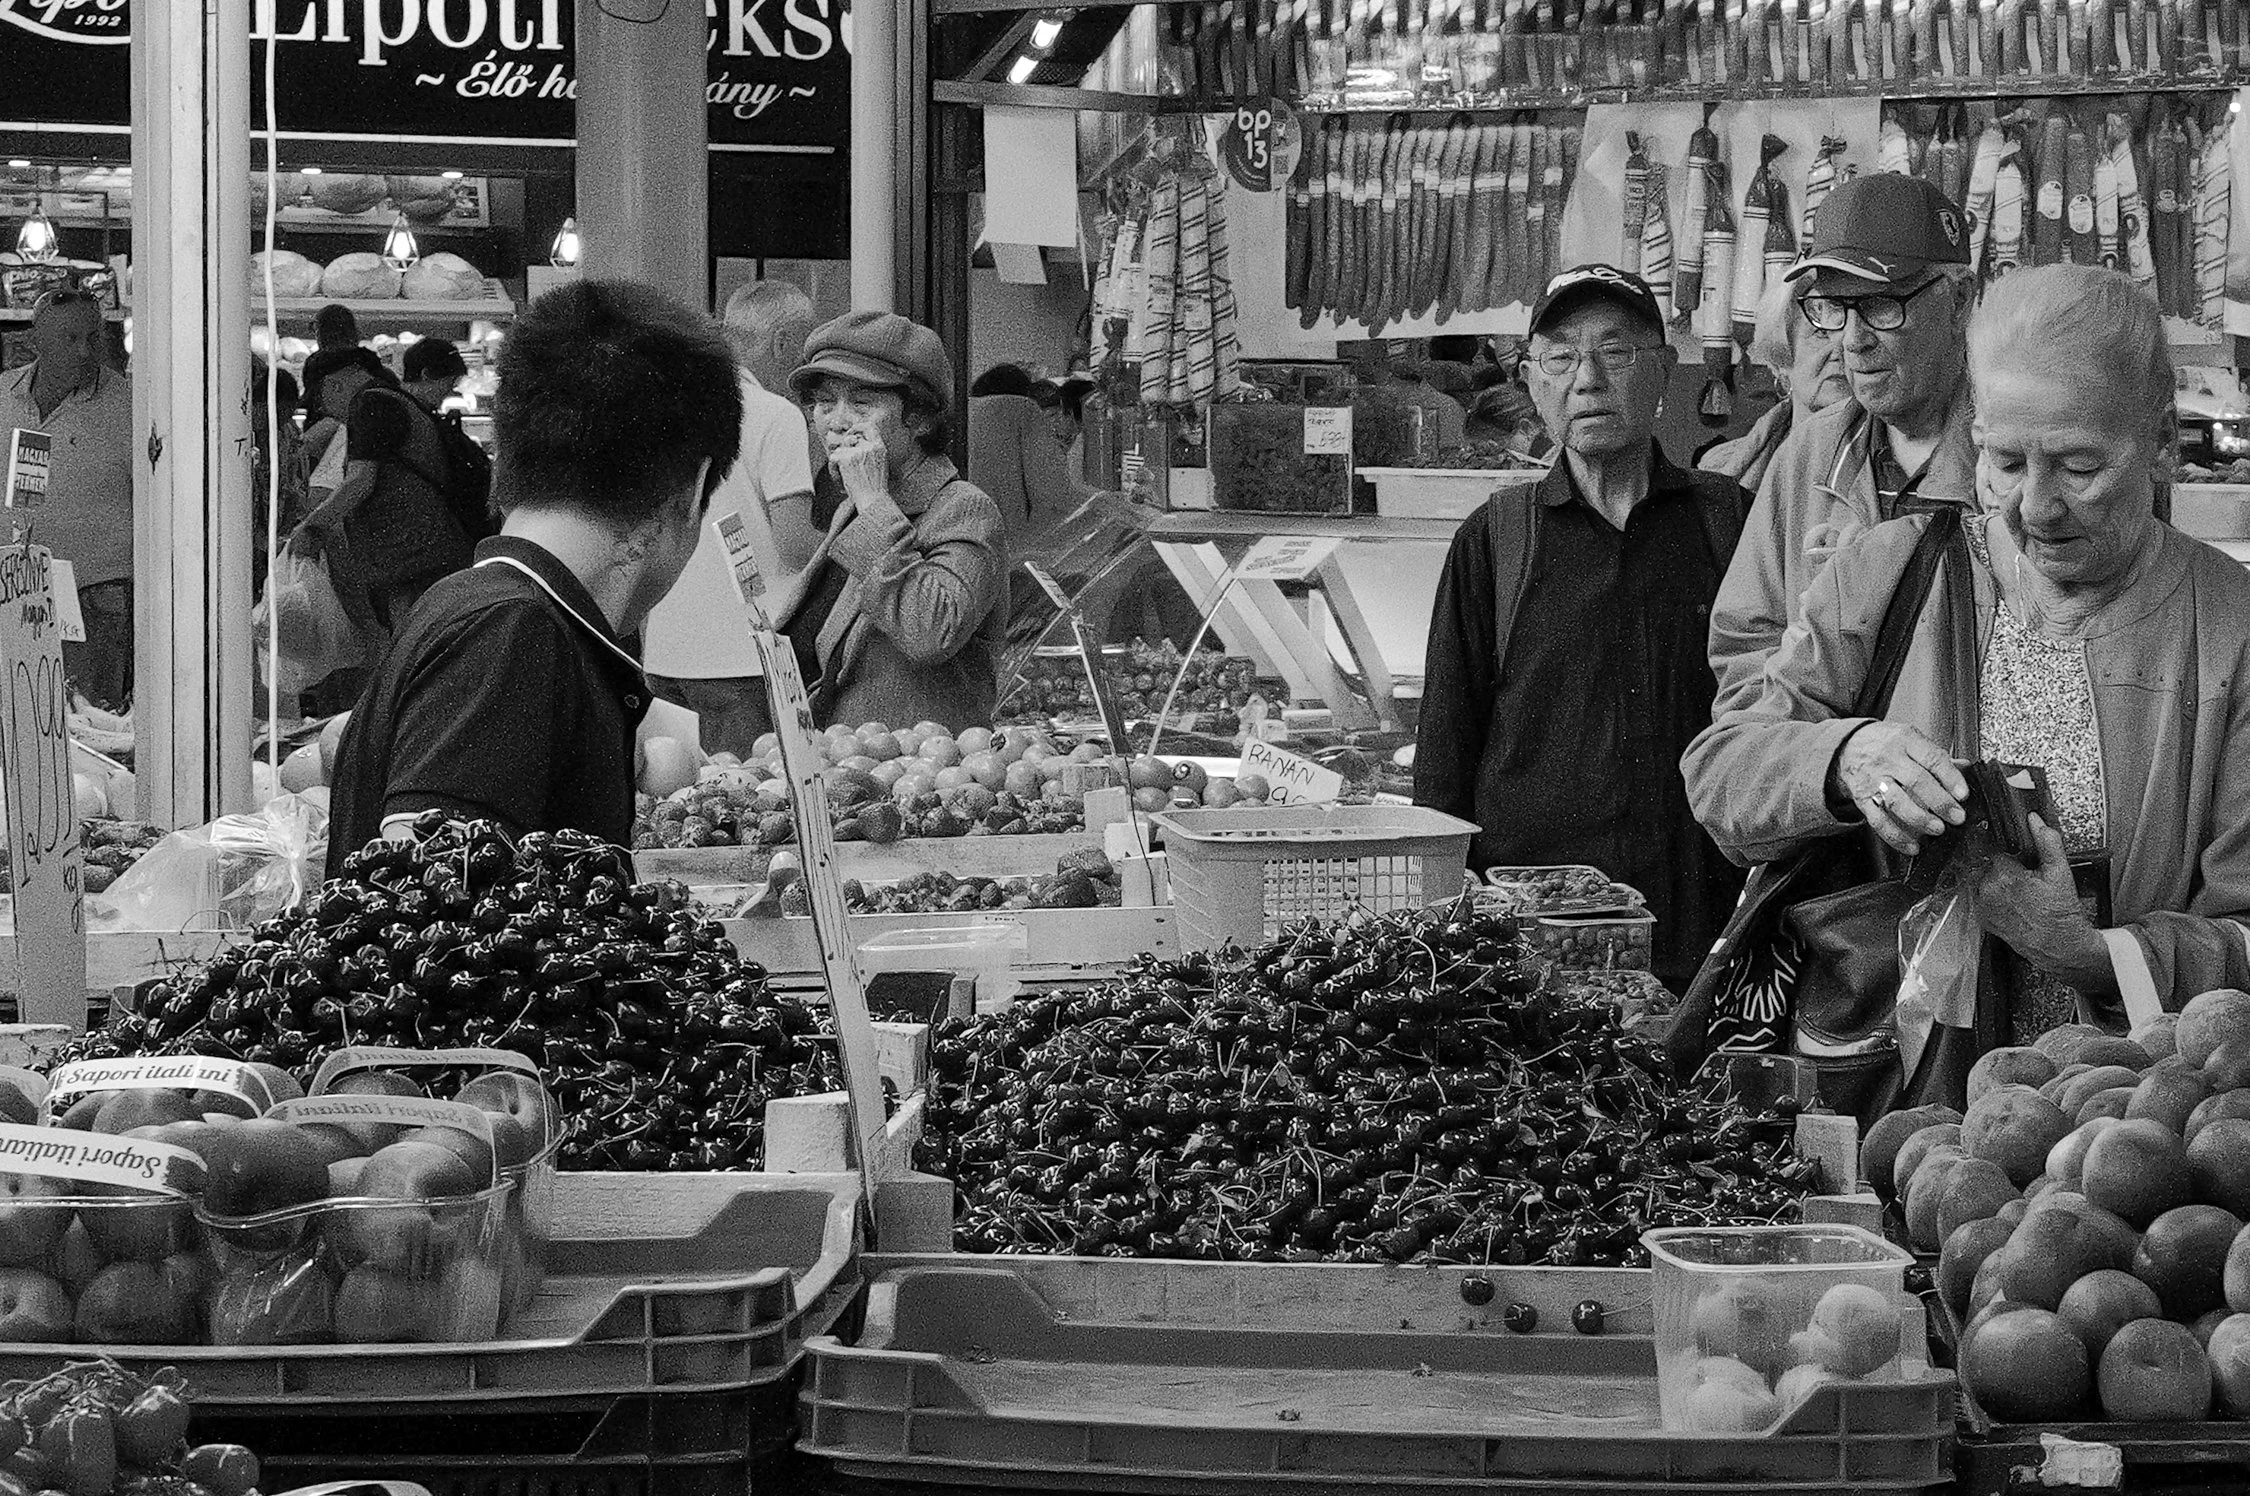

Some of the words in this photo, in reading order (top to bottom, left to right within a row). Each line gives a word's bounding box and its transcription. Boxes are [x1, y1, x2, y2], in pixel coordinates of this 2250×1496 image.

[74, 14, 121, 27] 1992
[455, 49, 537, 98] Élő
[1237, 106, 1272, 138] bp
[1243, 131, 1268, 169] 13
[66, 1065, 143, 1086] Sapori
[0, 1138, 76, 1167] italian
[78, 1146, 161, 1179] Sapori
